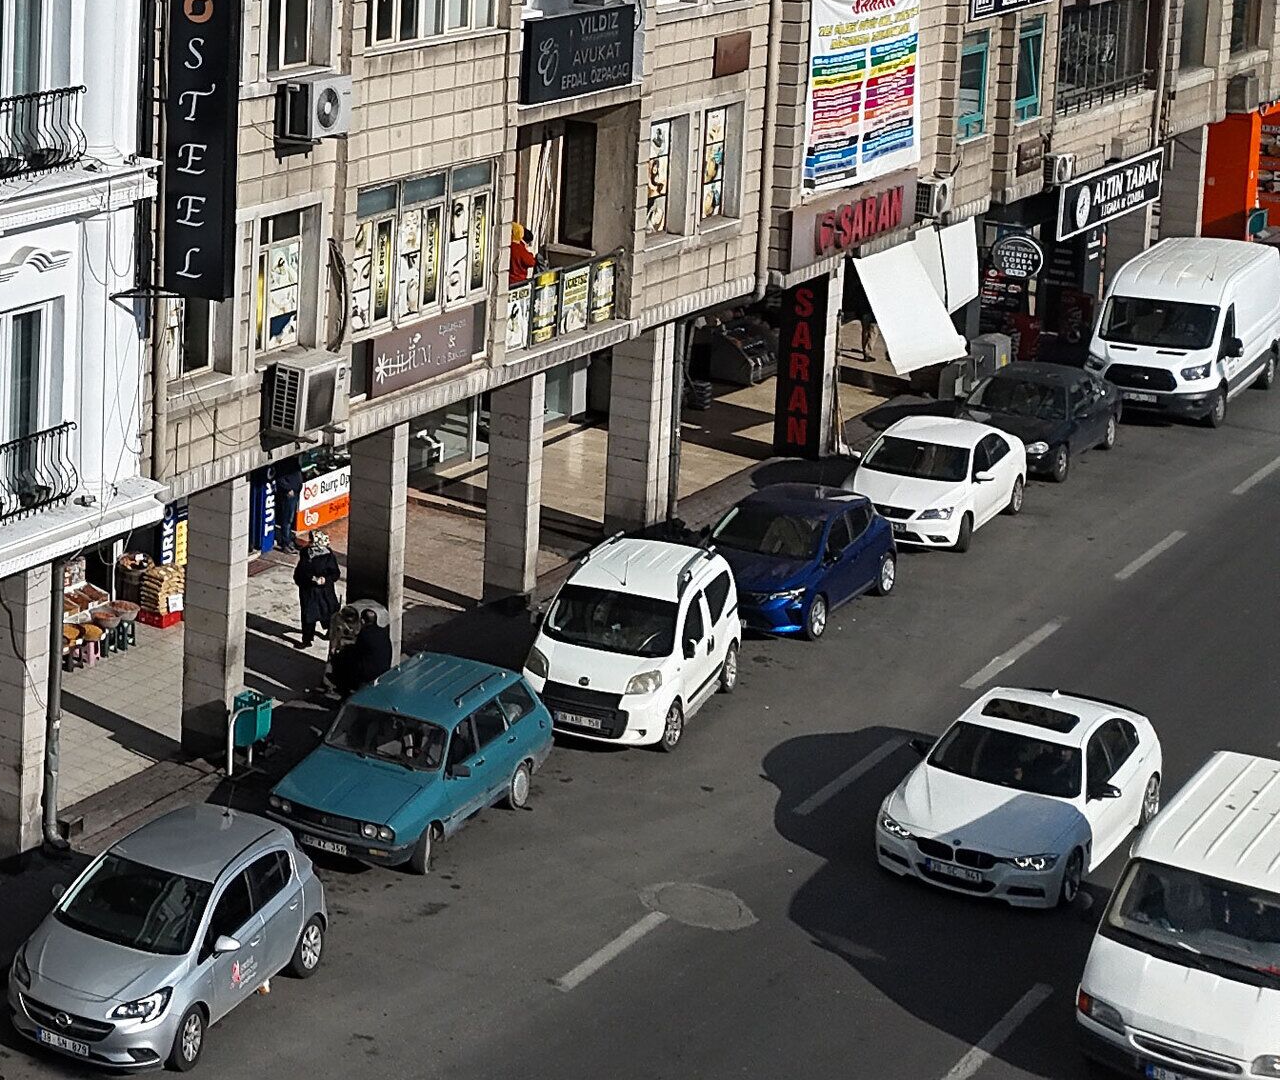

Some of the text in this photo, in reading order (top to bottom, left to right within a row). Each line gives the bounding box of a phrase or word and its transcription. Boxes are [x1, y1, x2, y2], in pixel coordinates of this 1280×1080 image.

[579, 12, 619, 35] YILDIZ
[572, 41, 621, 66] AVUKAT
[178, 37, 216, 279] STEEL
[1093, 159, 1159, 206] ALTIN TABAK
[838, 185, 904, 250] SARAN
[787, 287, 814, 446] SARAN
